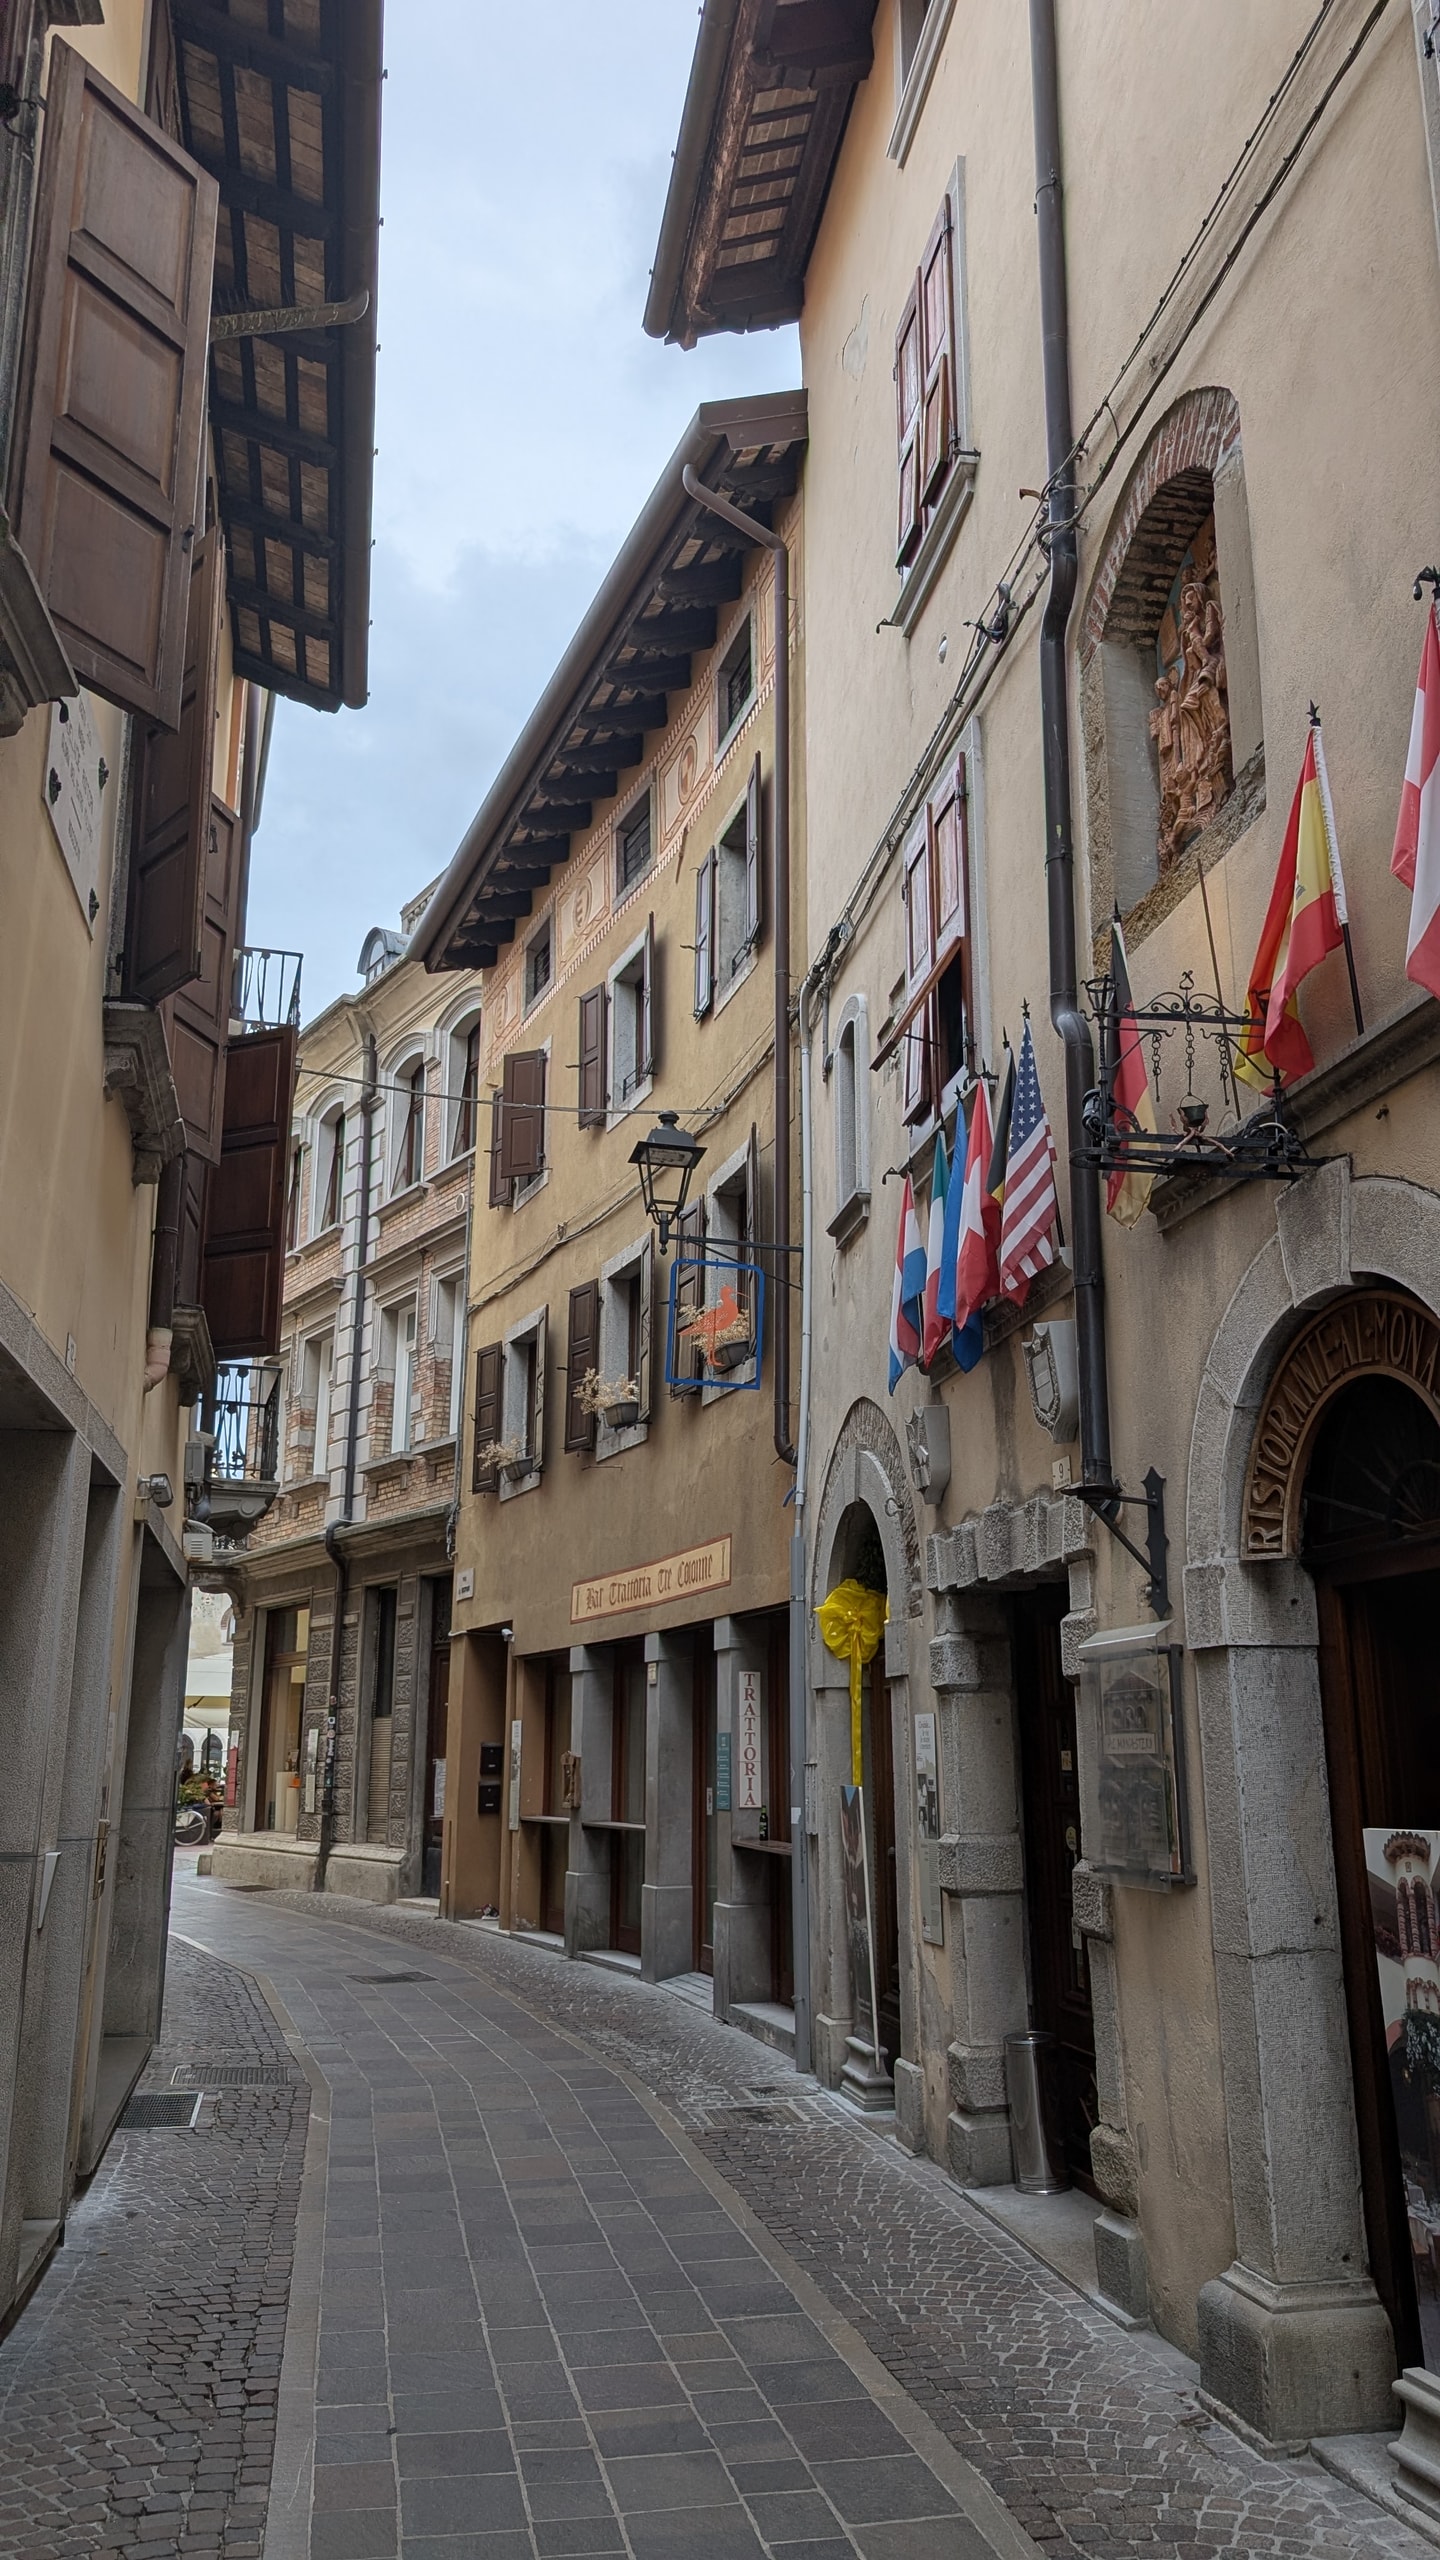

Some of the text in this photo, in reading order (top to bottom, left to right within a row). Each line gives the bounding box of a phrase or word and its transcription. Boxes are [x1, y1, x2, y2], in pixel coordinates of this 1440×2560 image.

[1059, 1463, 1064, 1479] 9
[1247, 1302, 1440, 1552] RISTORANTE AL MONA
[585, 1553, 713, 1612] Bar Trattoria Tre Colonne
[744, 1673, 757, 1806] TRATTORIA
